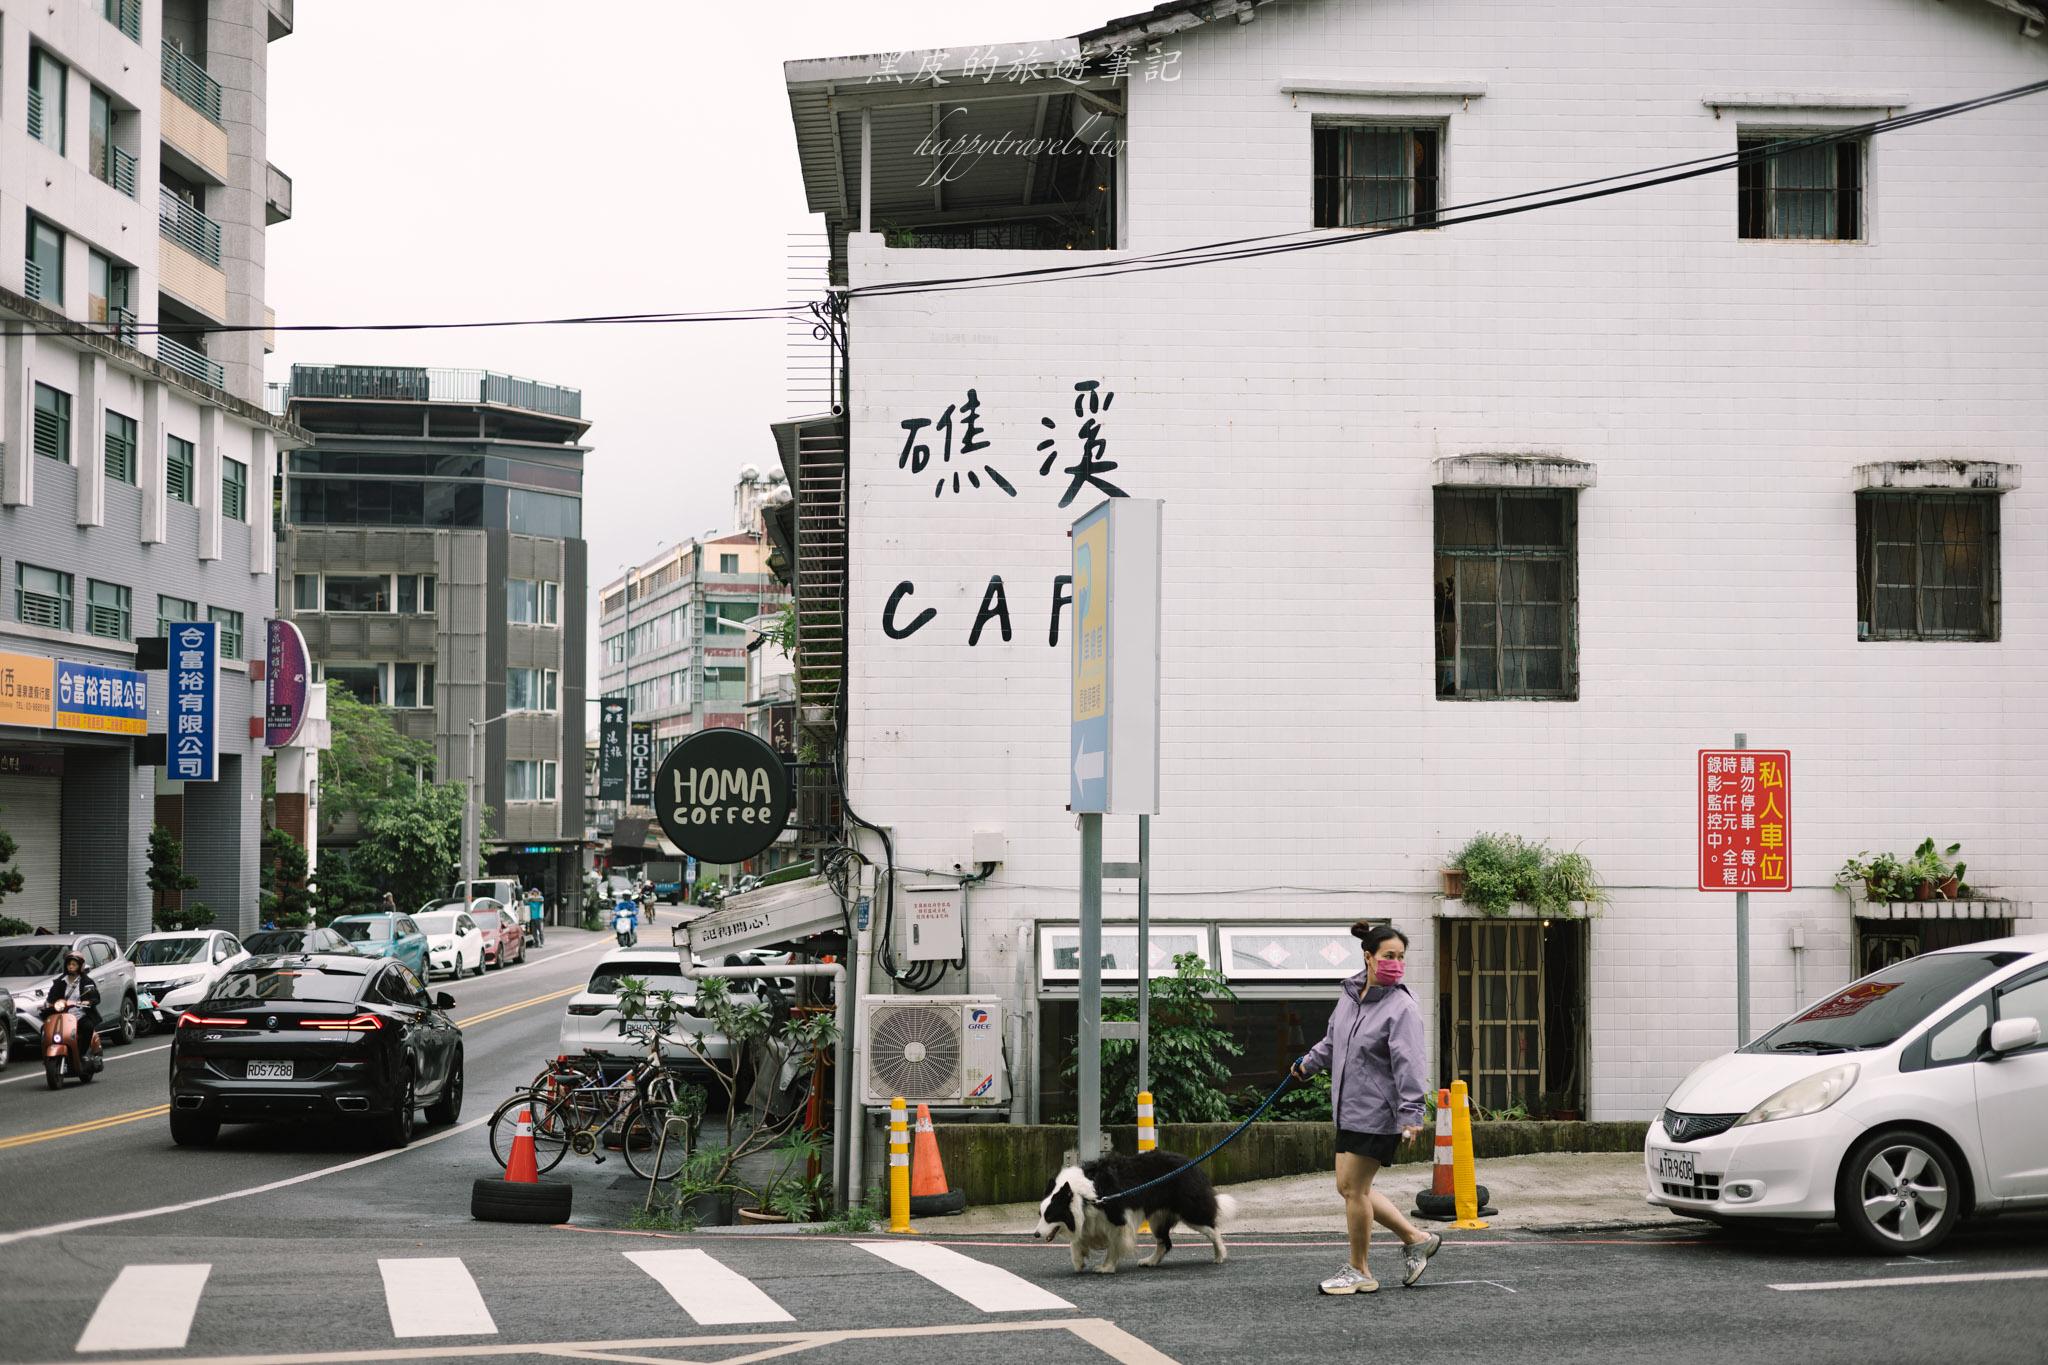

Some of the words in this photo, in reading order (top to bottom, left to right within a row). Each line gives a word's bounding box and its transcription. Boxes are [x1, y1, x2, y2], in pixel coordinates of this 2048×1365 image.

[899, 380, 1131, 508] 礁溪
[883, 574, 1073, 647] CAF
[60, 671, 146, 710] 合富裕有限公司
[178, 627, 206, 777] 合富裕有限公司
[632, 733, 649, 790] HOTEL
[673, 767, 772, 805] HOMA
[1722, 757, 1738, 885] 時一仟元，全程
[1740, 757, 1756, 885] 請勿停車，每小
[1759, 761, 1784, 880] 私人車位
[247, 1064, 293, 1077] RDS-7288
[1659, 1157, 1693, 1181] ATR-9608
